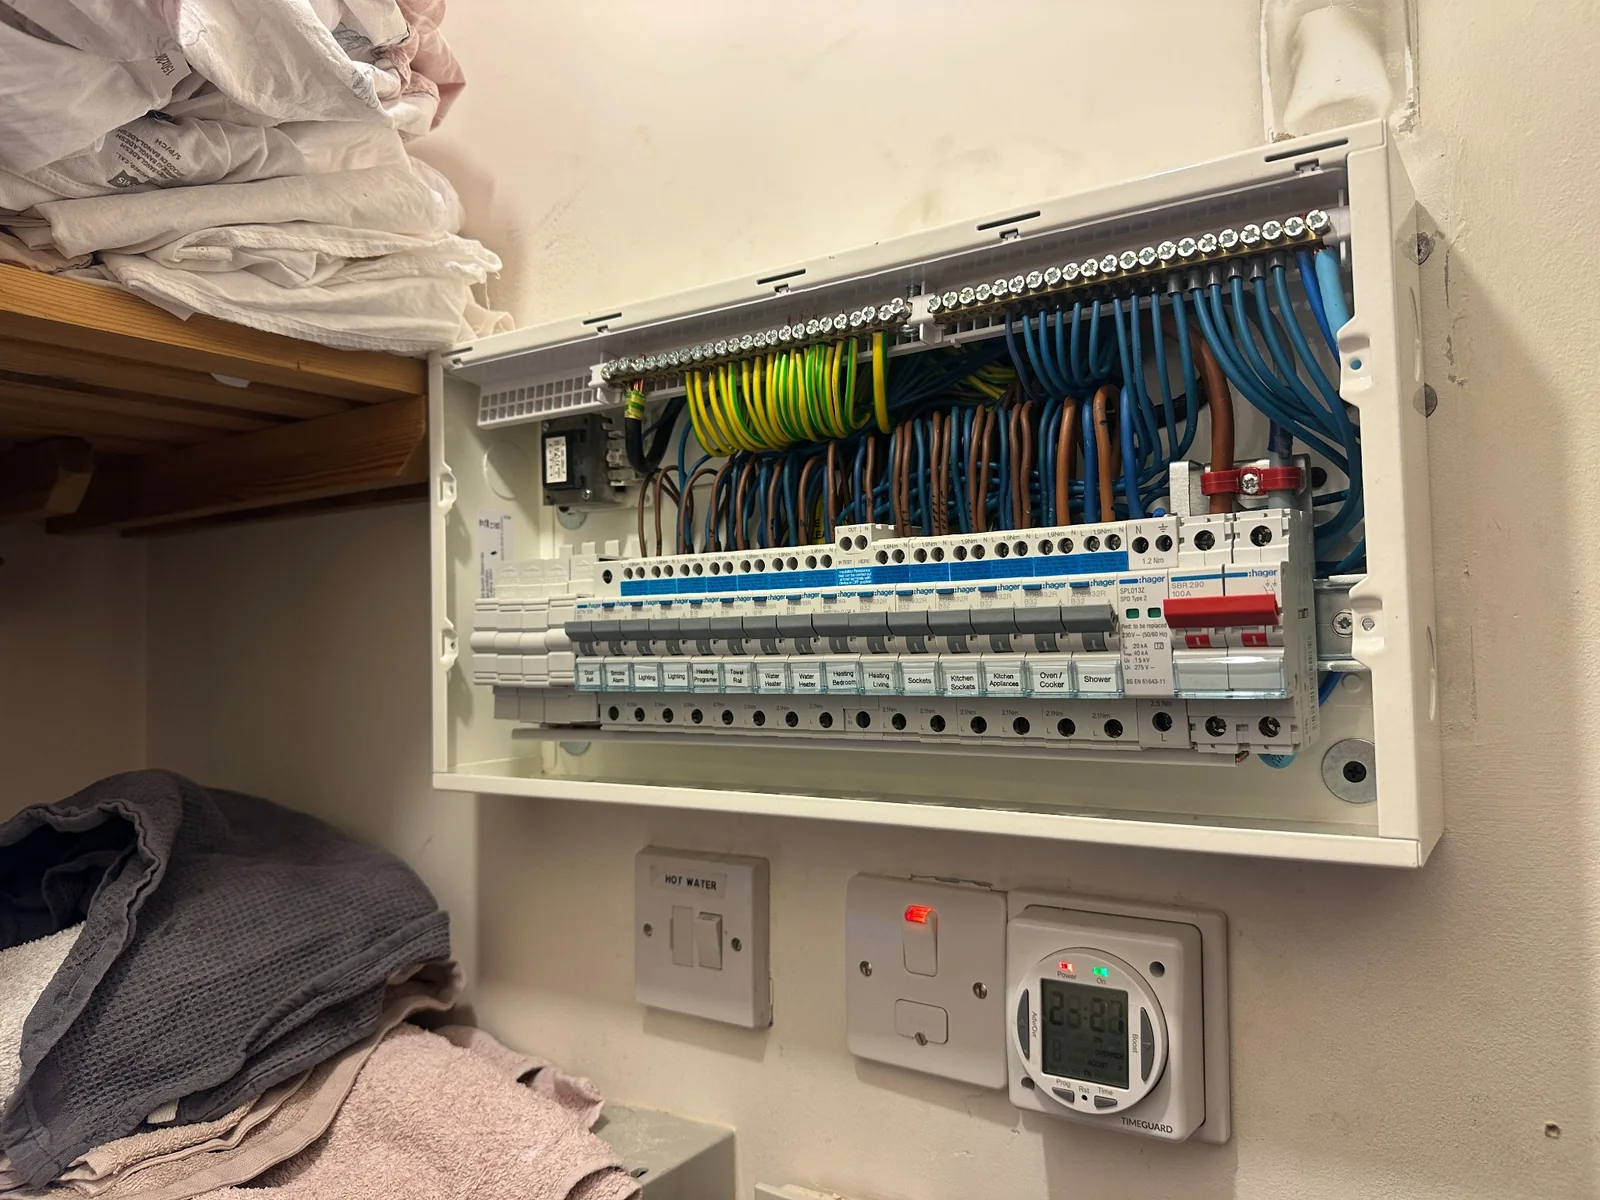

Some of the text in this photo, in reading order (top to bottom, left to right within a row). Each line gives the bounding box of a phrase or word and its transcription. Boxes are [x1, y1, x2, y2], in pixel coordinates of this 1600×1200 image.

[116, 133, 159, 166] BANGLADESH
[155, 138, 182, 160] S/P/CH
[1135, 525, 1142, 534] N
[1153, 556, 1164, 564] Nm
[638, 674, 656, 682] Lighting
[868, 672, 890, 680] Heating
[908, 676, 932, 684] Sockets
[1084, 675, 1112, 683] Shower
[872, 681, 890, 689] Living
[989, 680, 1020, 688] Appliances
[665, 874, 717, 891] HOT WATER
[1057, 970, 1076, 981] Power
[1096, 978, 1106, 986] On
[1056, 1078, 1071, 1088] Prog
[1078, 1086, 1090, 1095] Rst
[1097, 1086, 1114, 1096] Time
[1120, 1116, 1173, 1134] TIMEGUARD
